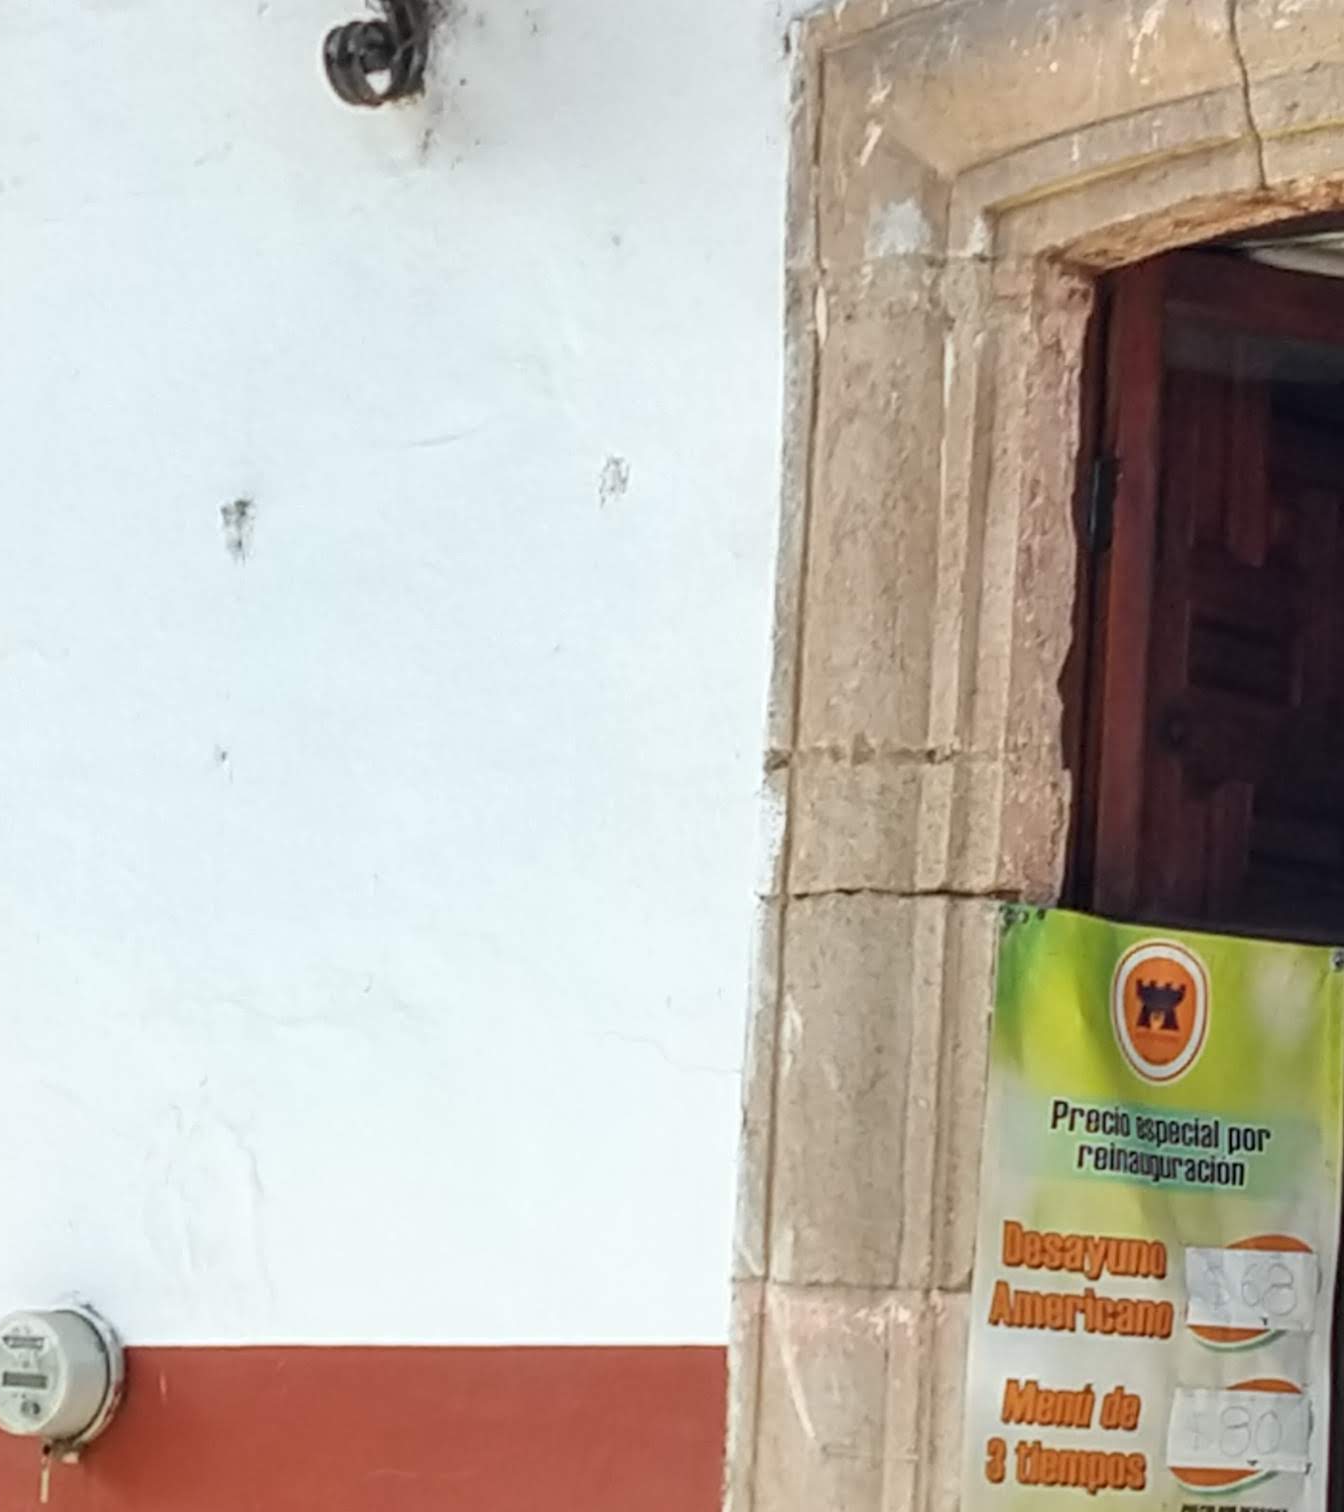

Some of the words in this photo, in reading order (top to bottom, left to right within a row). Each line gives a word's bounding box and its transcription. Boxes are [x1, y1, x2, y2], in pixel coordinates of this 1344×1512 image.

[1050, 1100, 1131, 1135] Precio
[1136, 1114, 1219, 1149] especial
[1227, 1124, 1271, 1155] por
[1077, 1144, 1246, 1186] reinauguración
[1002, 1220, 1167, 1279] Desayuno
[989, 1280, 1174, 1338] Americano
[1001, 1378, 1095, 1429] Menú
[1100, 1386, 1141, 1430] de
[985, 1437, 1006, 1483] 3
[1015, 1439, 1146, 1495] tiempos
